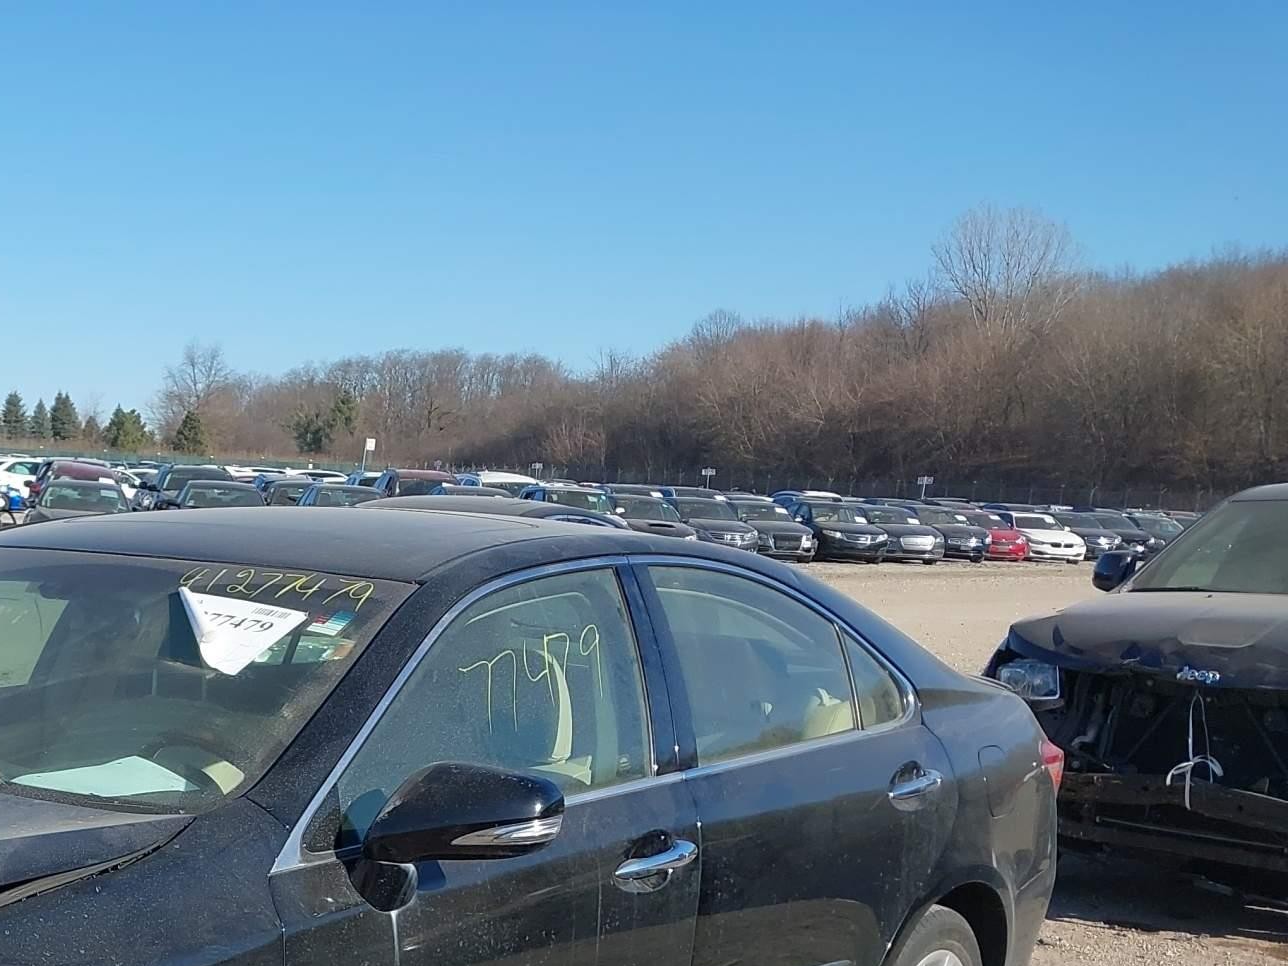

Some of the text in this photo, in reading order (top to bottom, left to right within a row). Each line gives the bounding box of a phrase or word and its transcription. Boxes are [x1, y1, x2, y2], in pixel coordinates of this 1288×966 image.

[179, 566, 374, 612] 41277479
[204, 610, 274, 633] 77479
[458, 624, 603, 736] 77479
